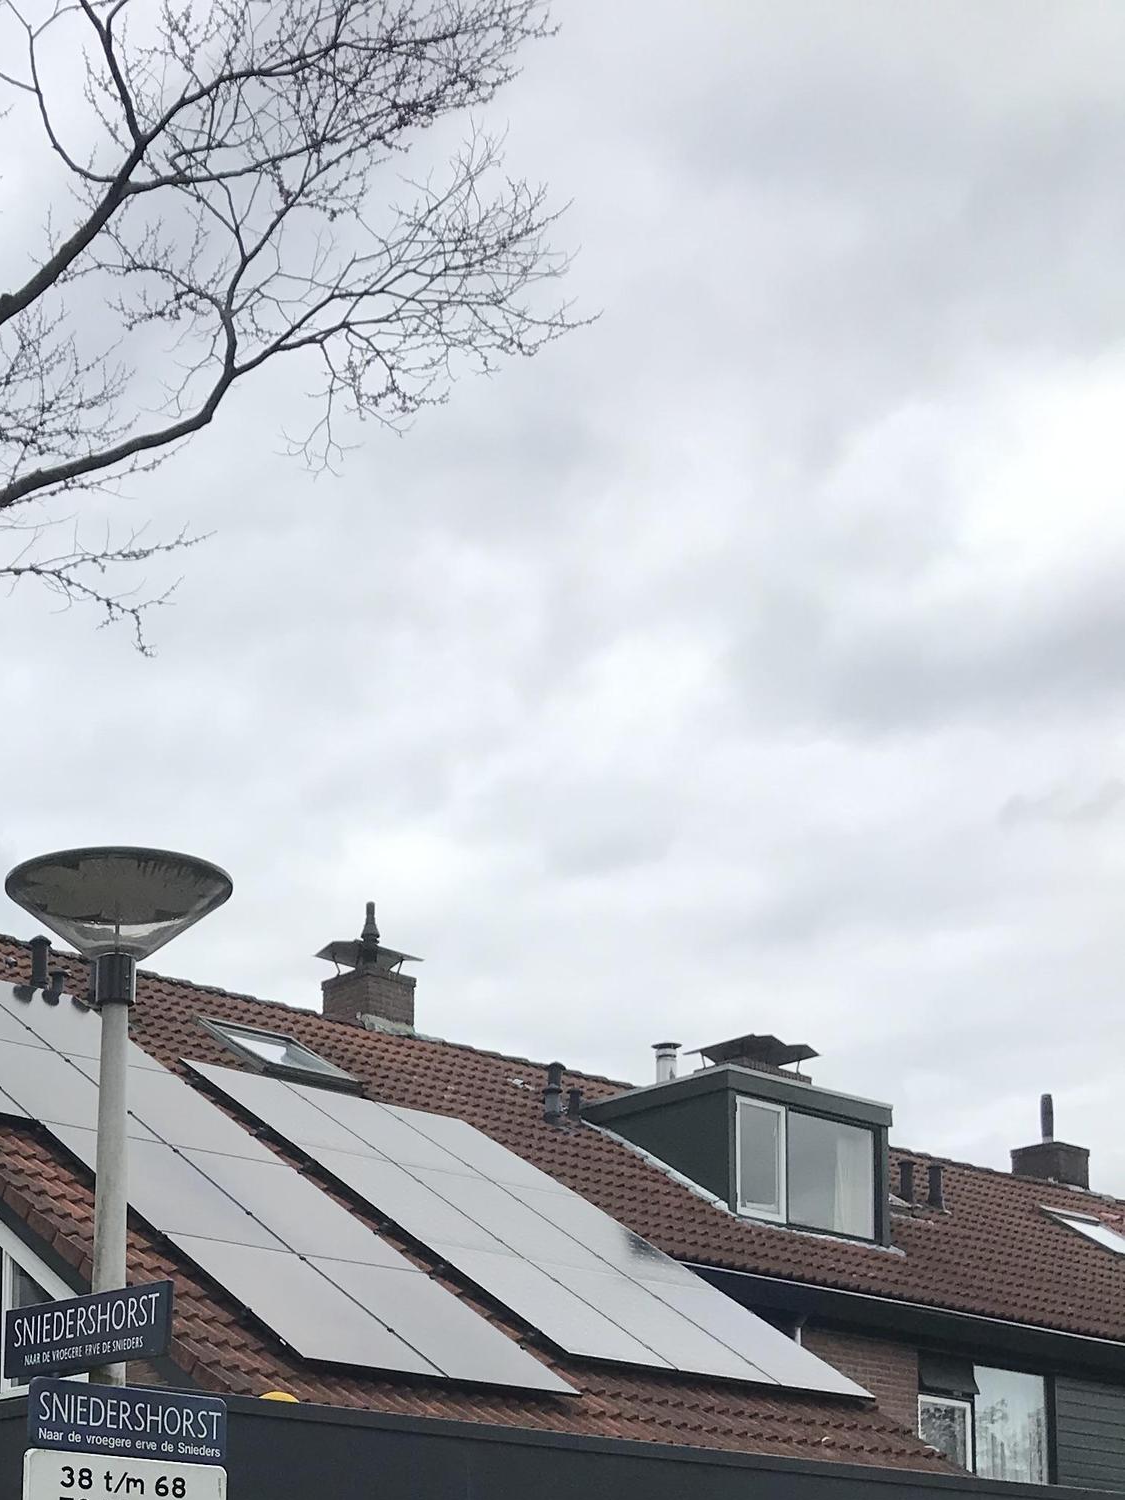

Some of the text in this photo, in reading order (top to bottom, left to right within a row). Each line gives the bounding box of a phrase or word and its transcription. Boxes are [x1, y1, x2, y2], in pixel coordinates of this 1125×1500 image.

[13, 1292, 160, 1348] SNIEDERSHORST
[24, 1352, 41, 1367] NAAR
[42, 1350, 51, 1364] DE
[85, 1343, 101, 1356] ERVE
[102, 1341, 111, 1354] DE
[112, 1336, 144, 1352] SNIEDERS
[38, 1391, 222, 1440] SNIEDERSHORST
[38, 1427, 221, 1458] Naar de vroegere erve de Snieders
[60, 1466, 186, 1499] 38 t/m 68
